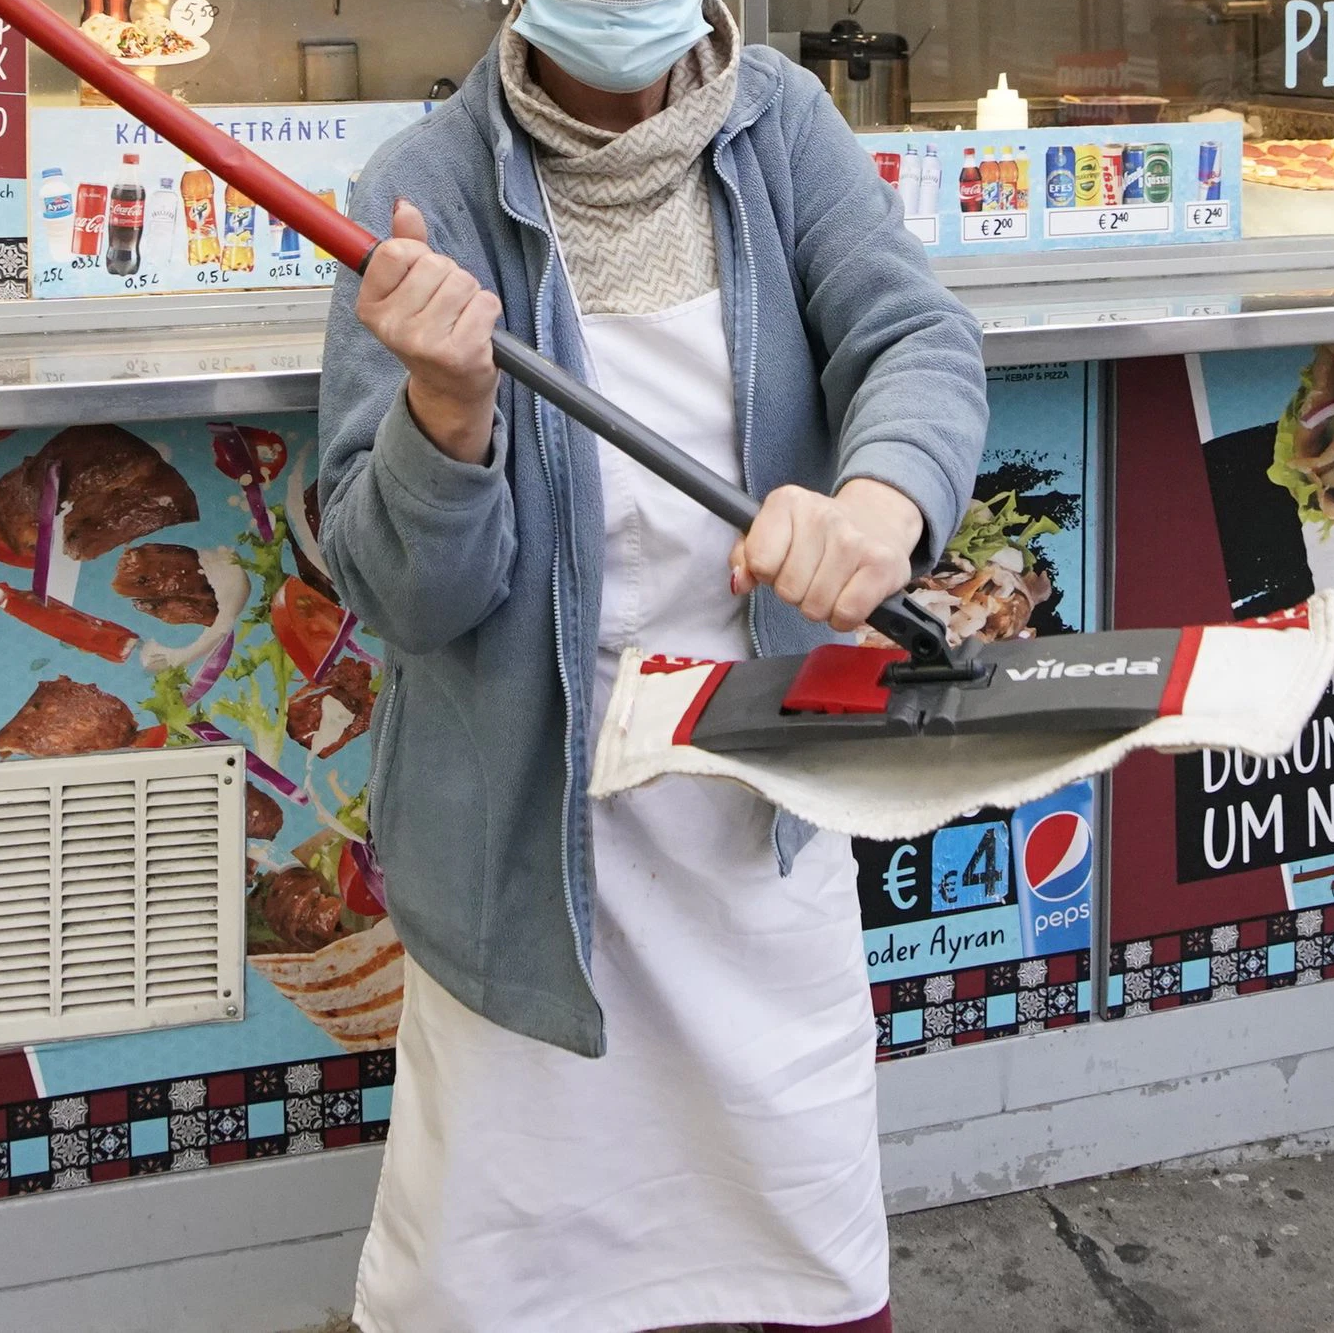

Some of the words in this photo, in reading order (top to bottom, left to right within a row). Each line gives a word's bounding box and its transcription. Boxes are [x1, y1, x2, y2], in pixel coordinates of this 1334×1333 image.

[1006, 657, 1159, 681] vileda
[1203, 793, 1284, 870] UM
[1035, 901, 1089, 936] peps
[867, 934, 920, 966] oder
[930, 925, 1005, 964] Ayran
